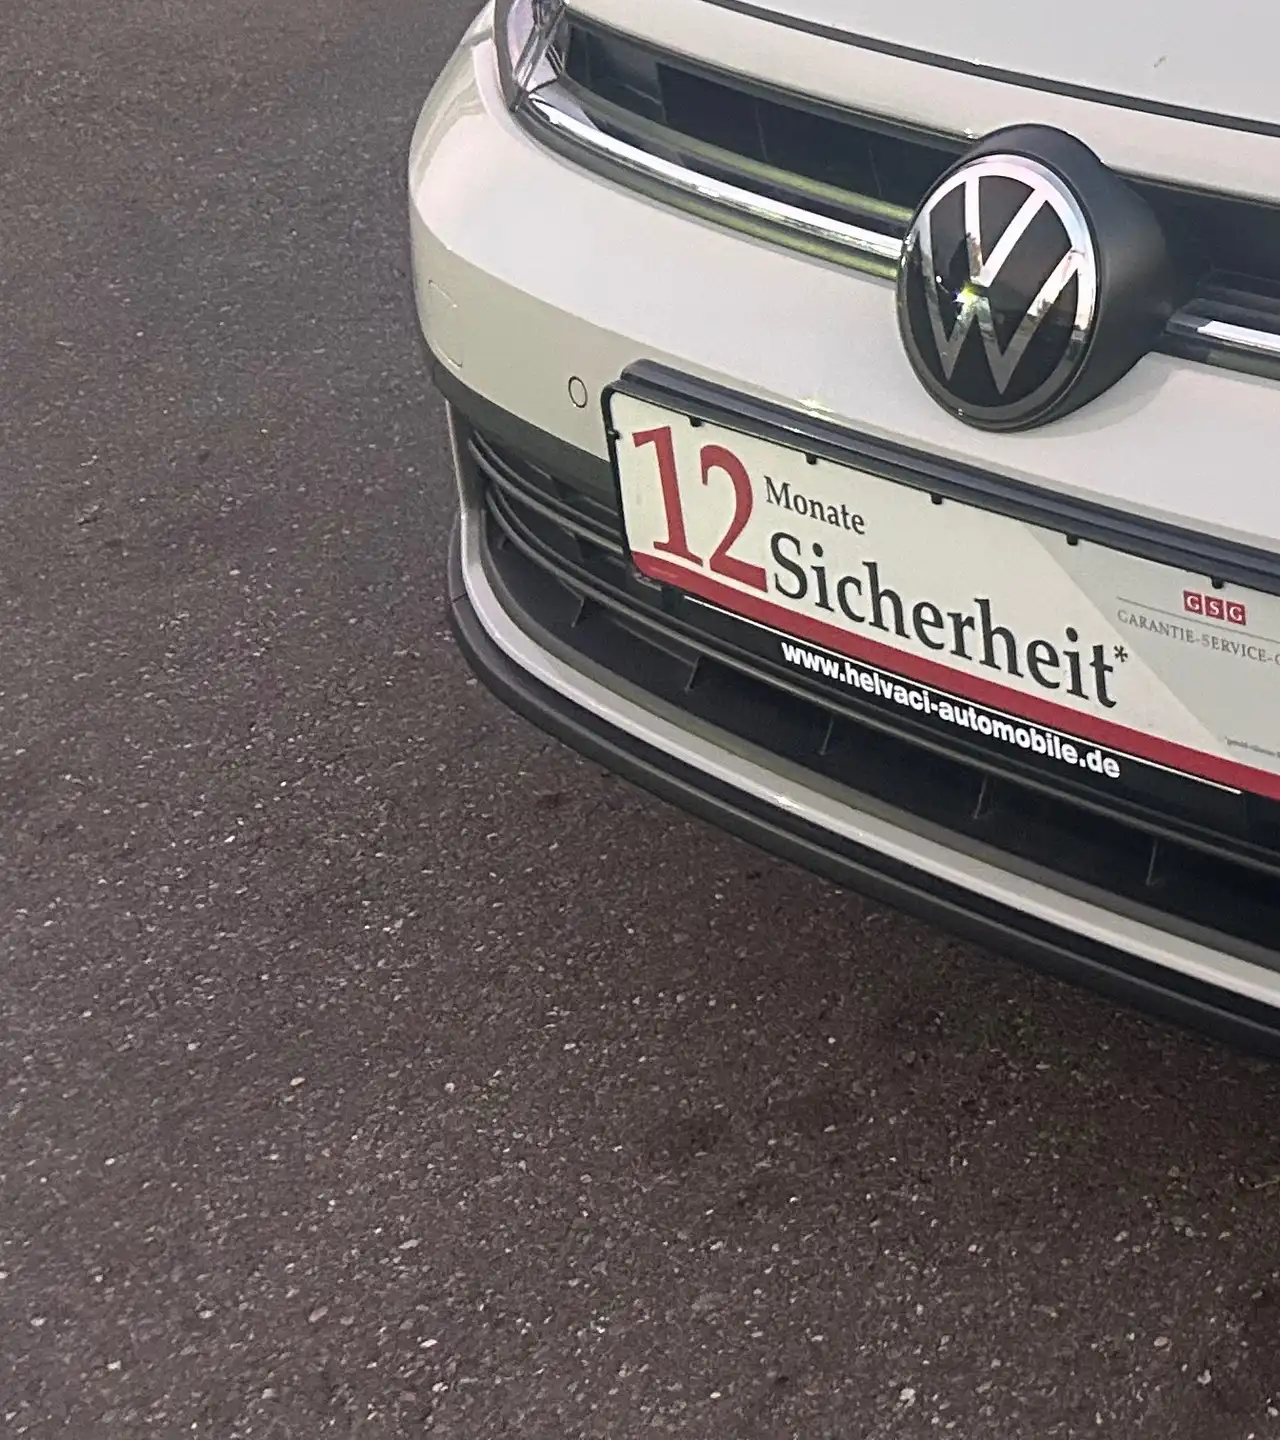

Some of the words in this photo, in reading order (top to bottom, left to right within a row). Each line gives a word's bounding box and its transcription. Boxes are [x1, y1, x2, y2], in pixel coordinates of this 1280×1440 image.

[632, 425, 769, 593] 12
[763, 475, 866, 535] Monate
[1184, 592, 1245, 624] GSG
[779, 641, 1122, 780] www.helvaci-automobile.de
